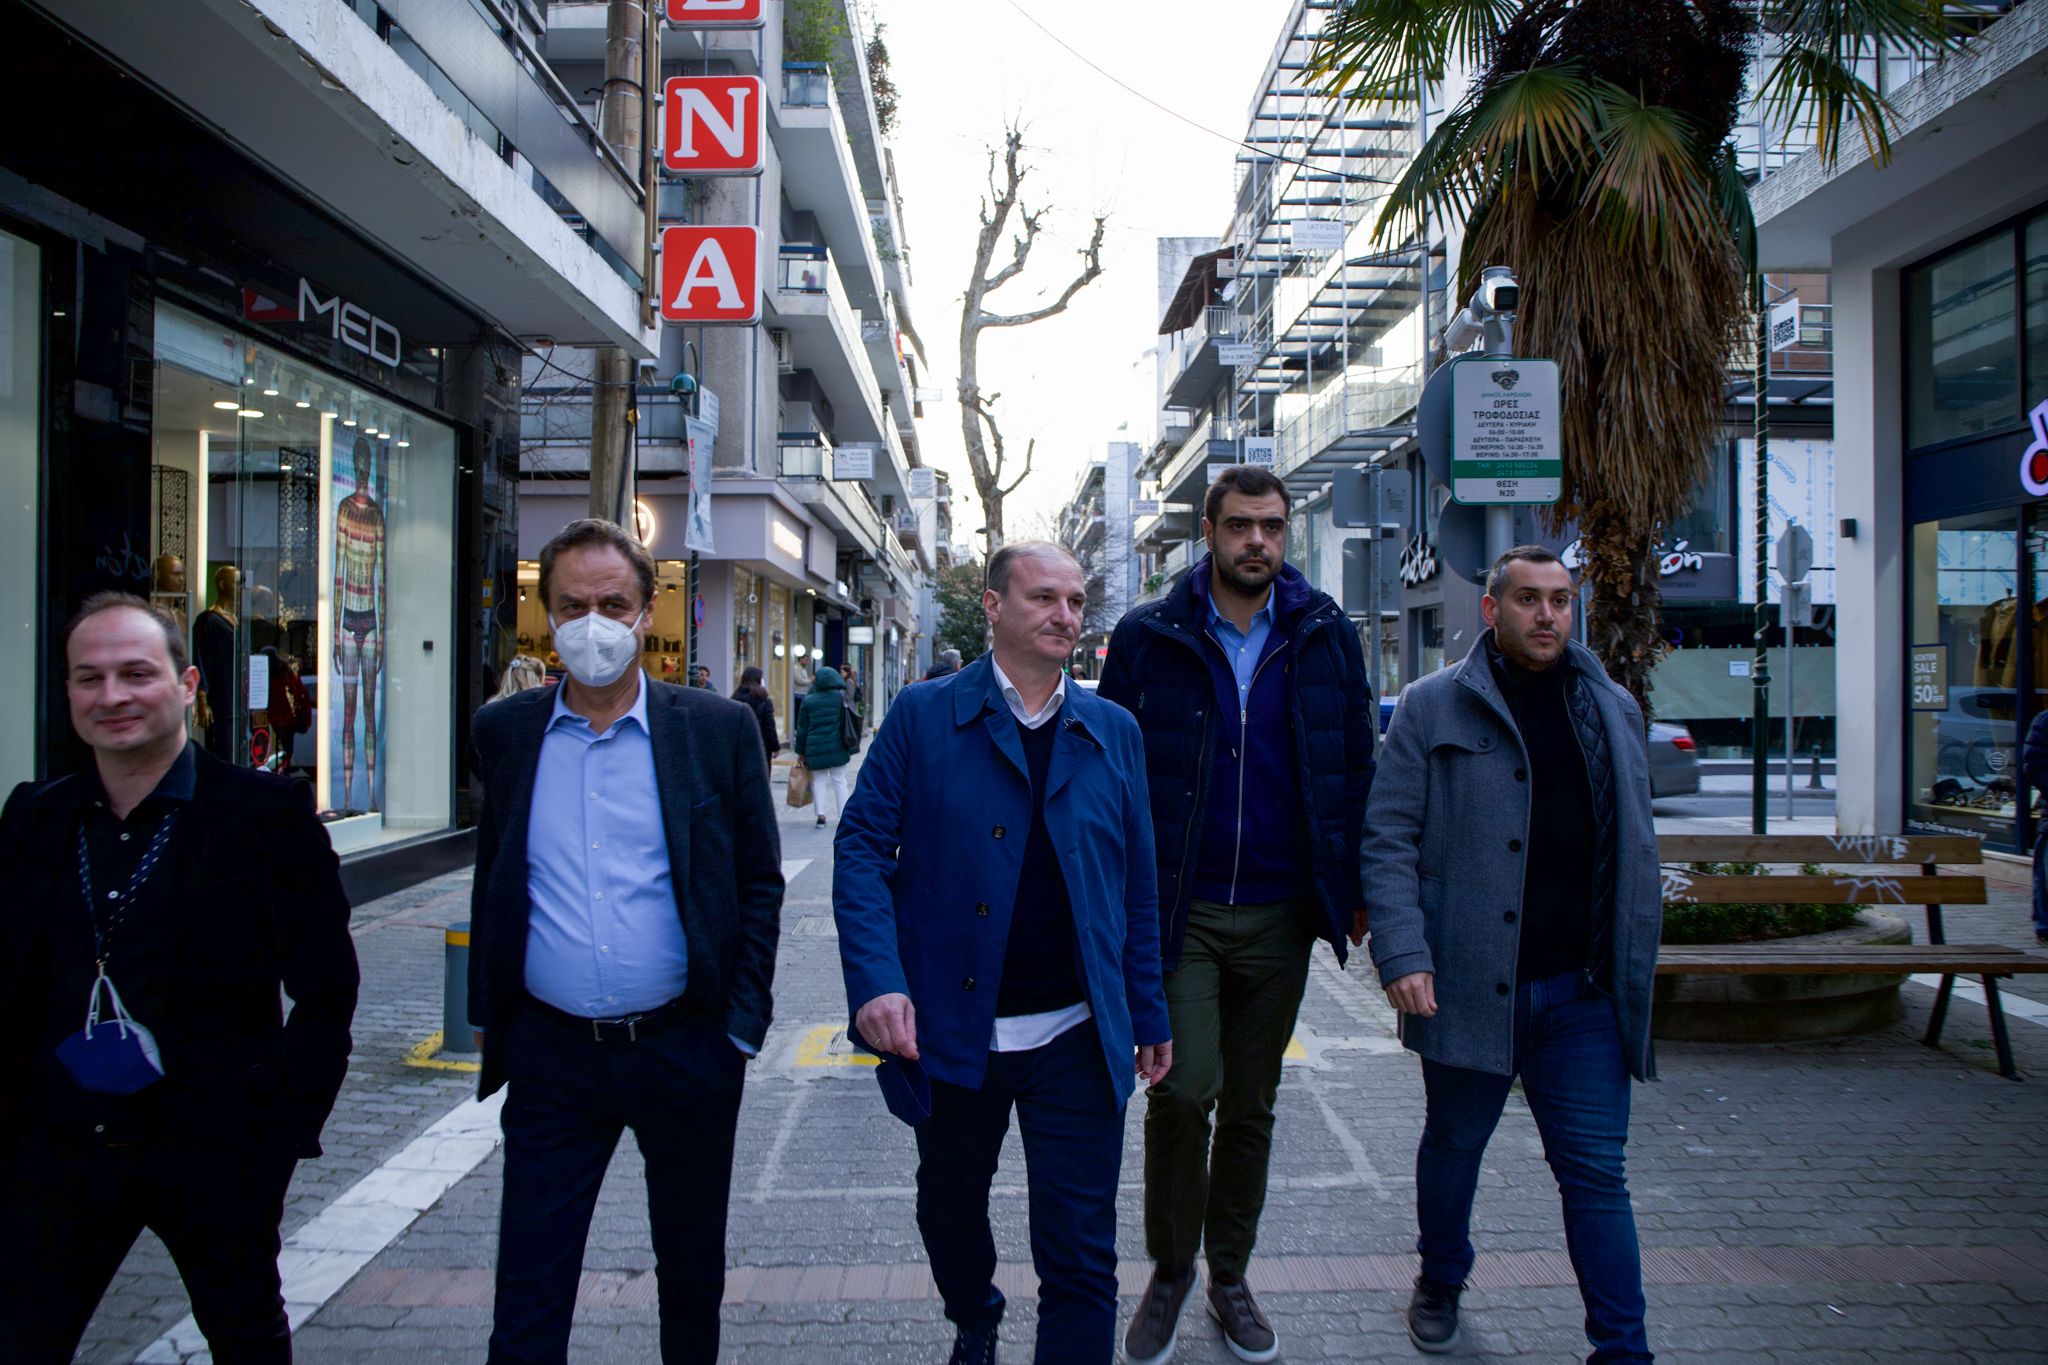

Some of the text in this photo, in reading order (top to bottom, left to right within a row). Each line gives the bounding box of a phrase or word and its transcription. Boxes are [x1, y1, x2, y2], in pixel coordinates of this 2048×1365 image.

[298, 277, 401, 368] MED
[1493, 400, 1519, 408] ΩΡΕΣ
[1472, 411, 1541, 420] ΤΡΟΦΟΔΟΣΙΑΣ
[1496, 480, 1519, 488] ΘΕΣΗ
[1914, 662, 1937, 673] SALE
